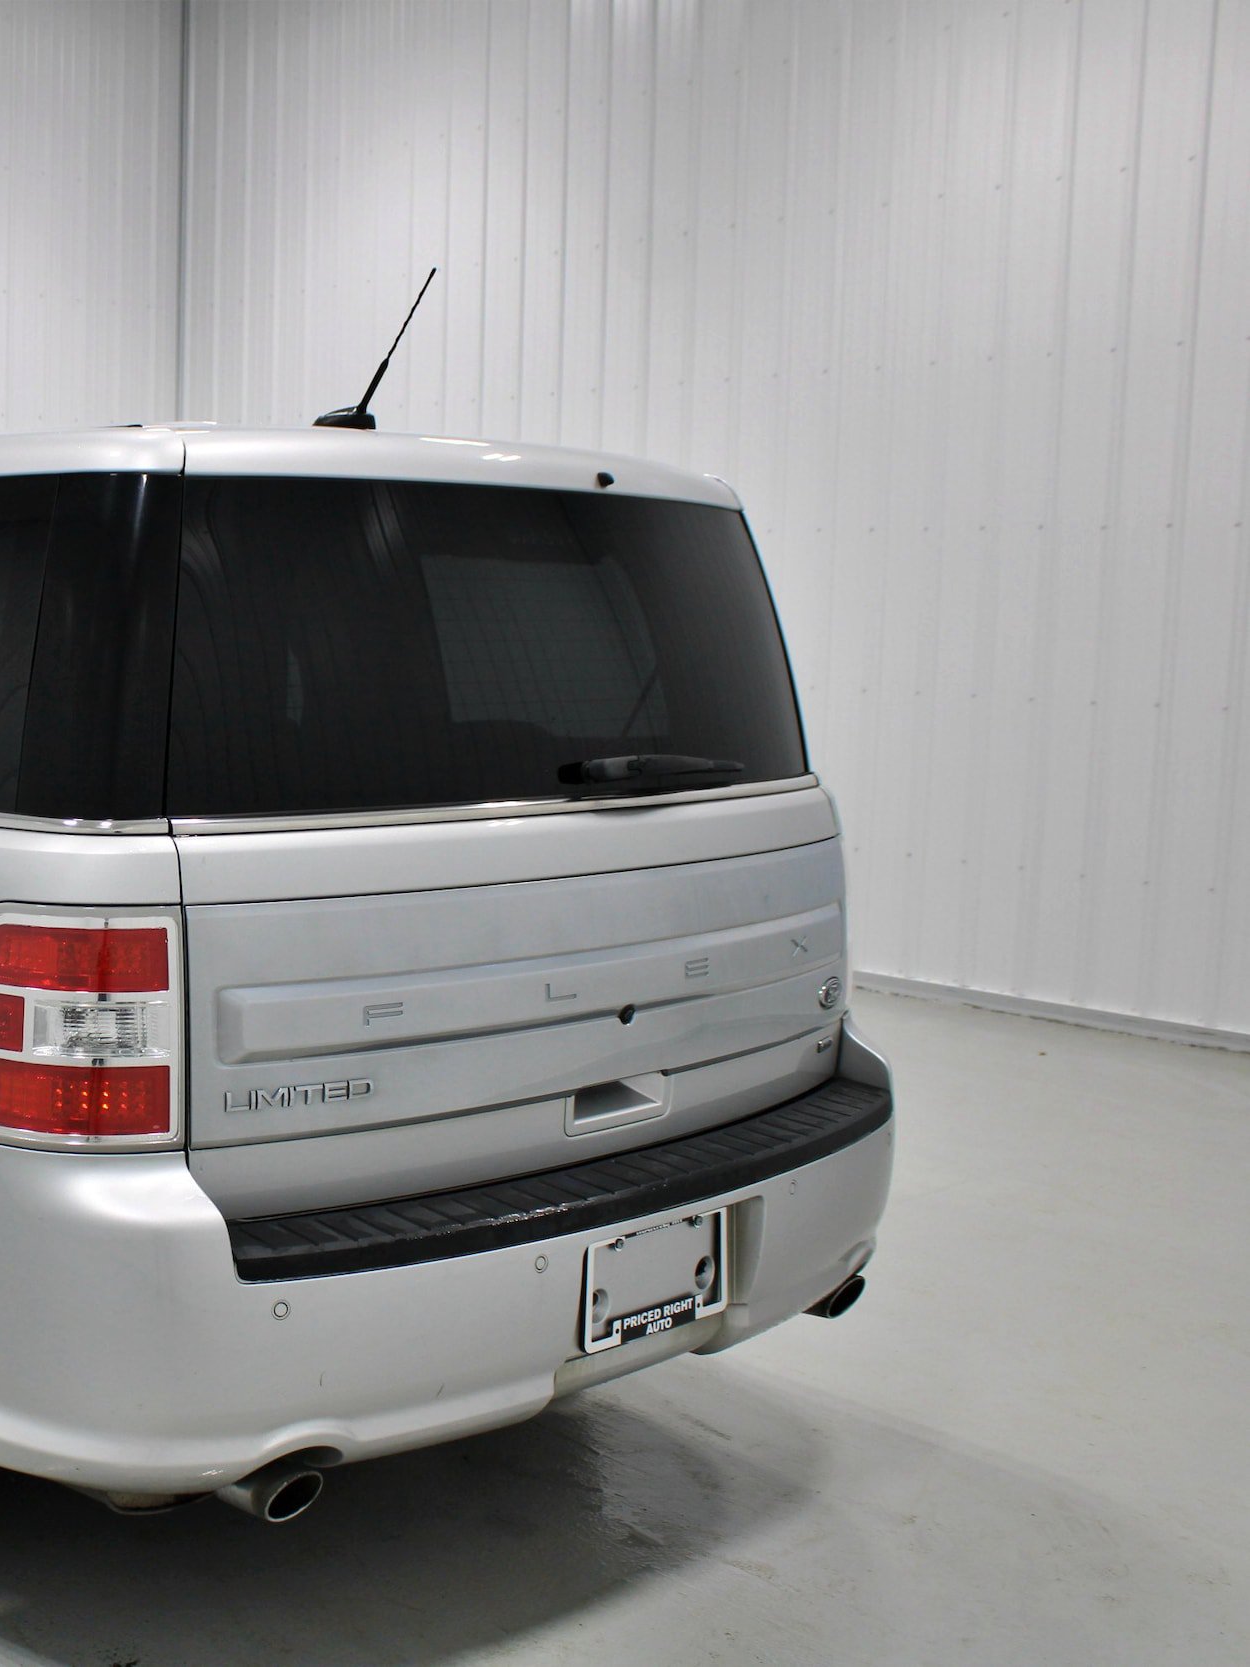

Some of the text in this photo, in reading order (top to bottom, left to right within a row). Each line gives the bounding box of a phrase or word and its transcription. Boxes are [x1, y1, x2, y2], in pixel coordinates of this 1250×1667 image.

[362, 935, 808, 1028] FLEX
[224, 1077, 375, 1113] LIMITED
[623, 1298, 694, 1330] PRICED RIGHT
[646, 1316, 673, 1335] AUTO
